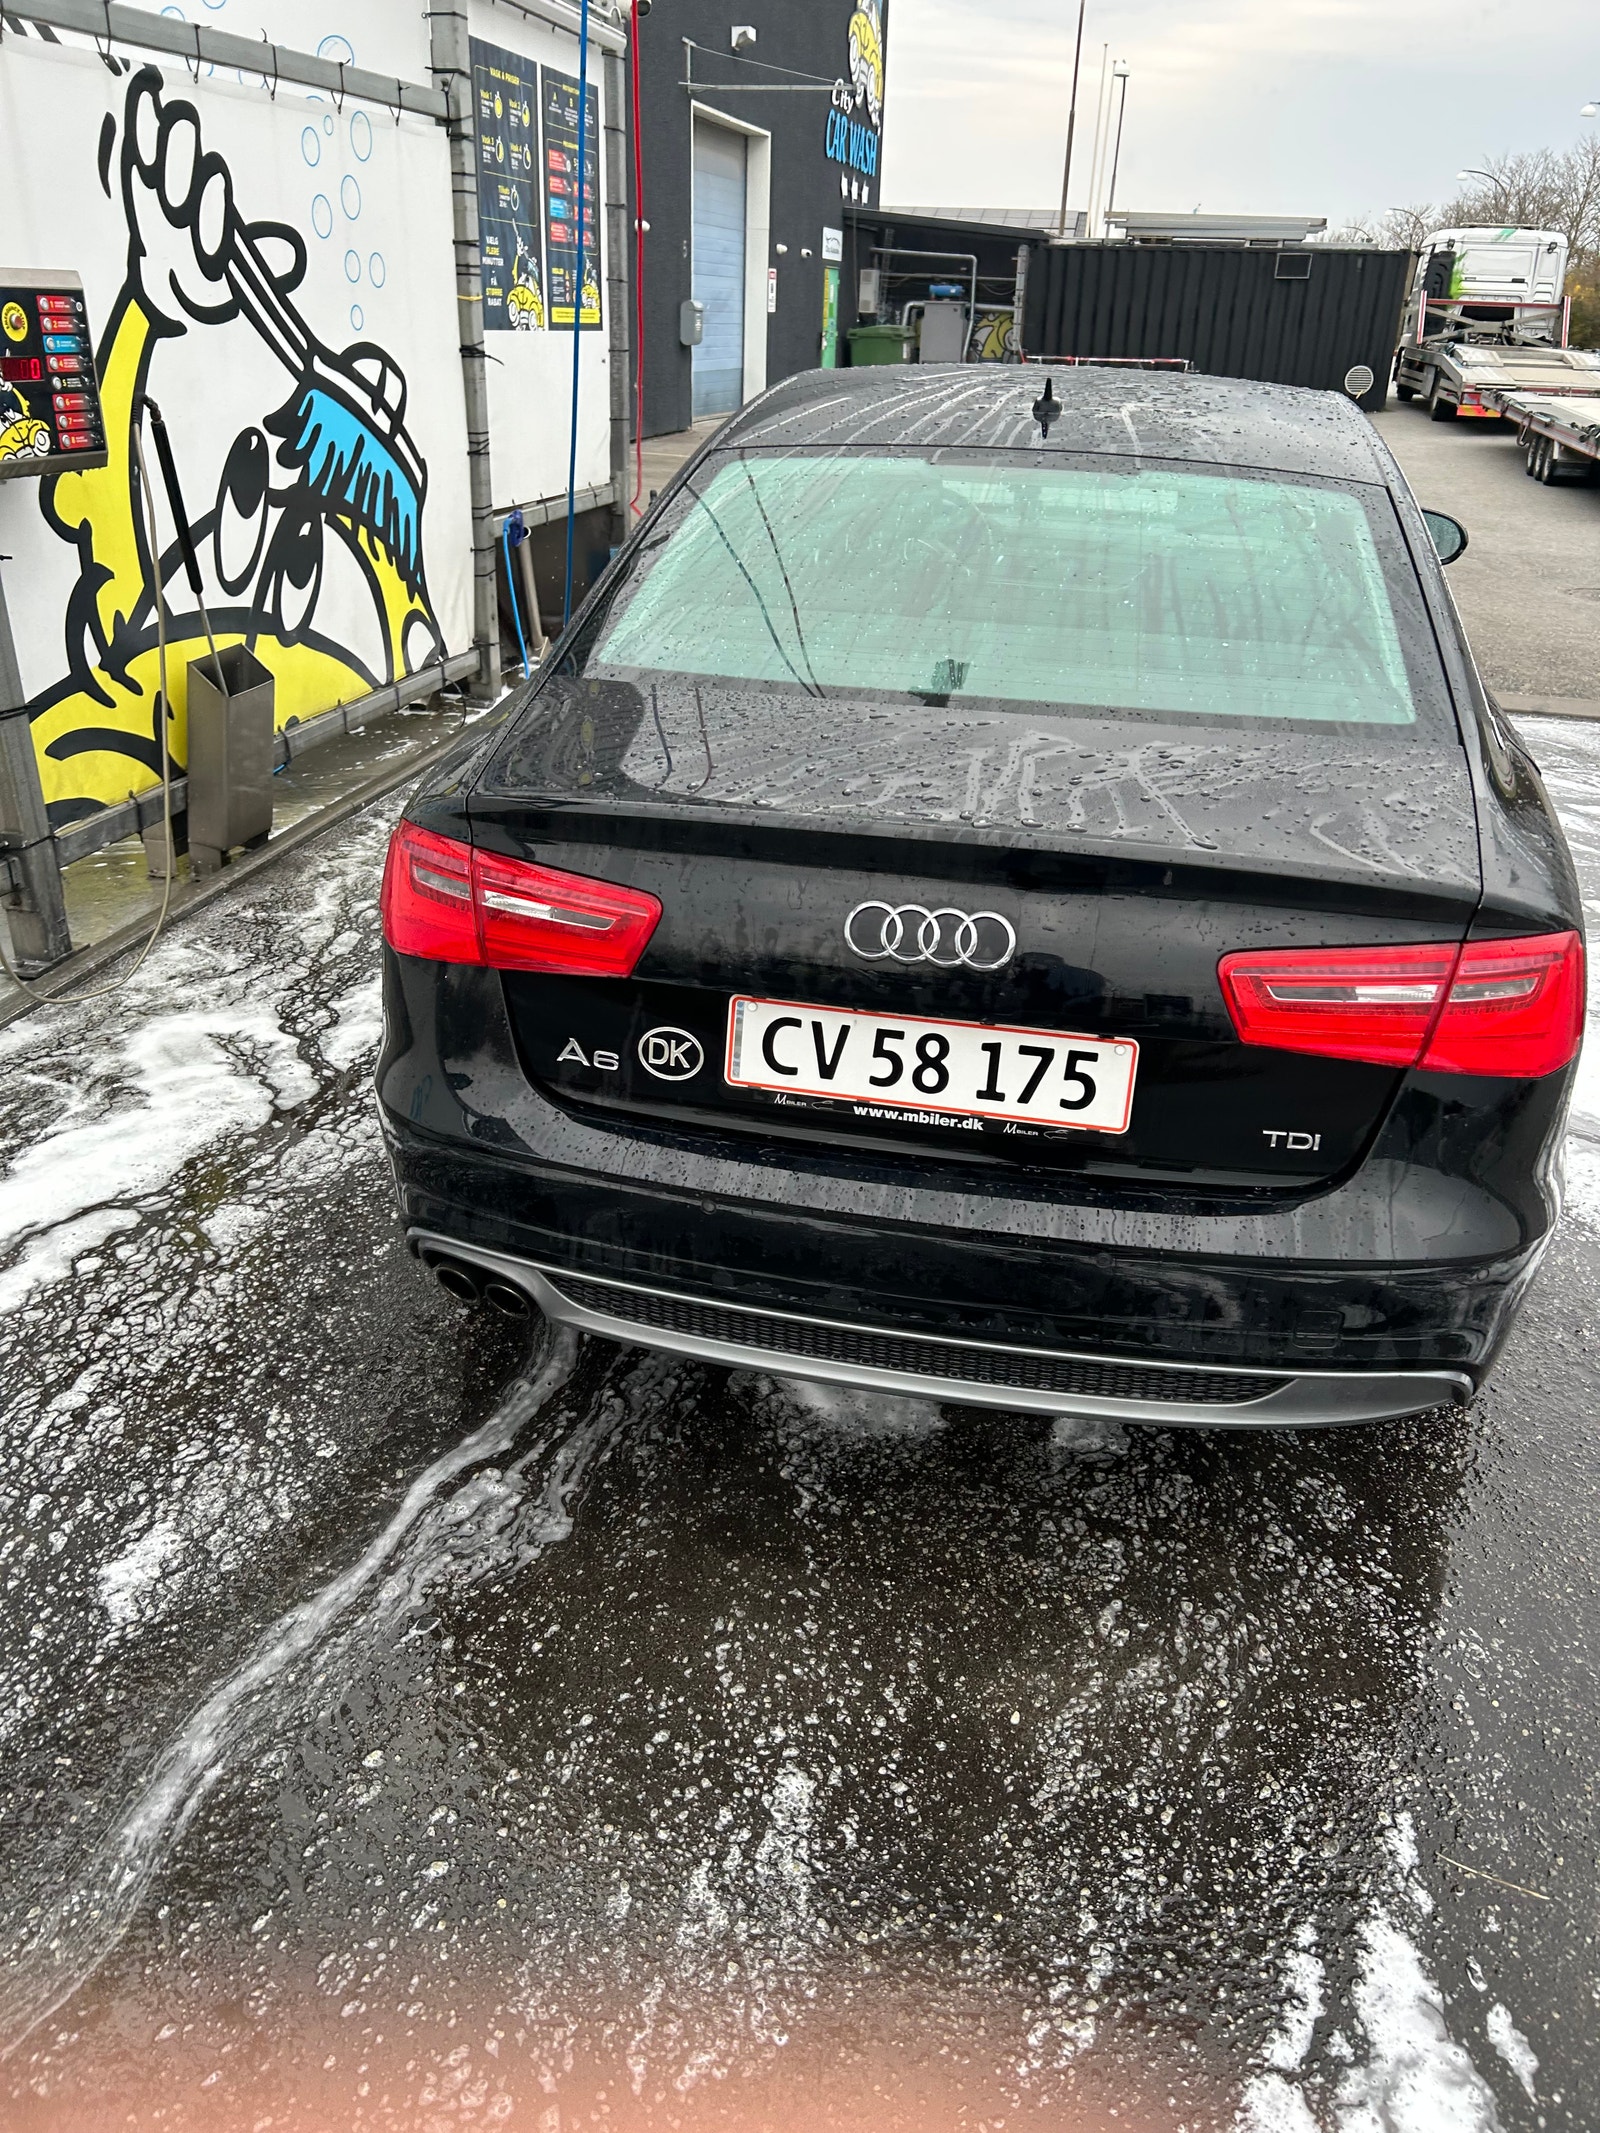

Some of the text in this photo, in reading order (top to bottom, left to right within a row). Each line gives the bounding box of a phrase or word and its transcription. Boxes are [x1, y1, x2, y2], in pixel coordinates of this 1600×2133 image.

[832, 78, 854, 114] City
[826, 109, 878, 177] CAR WASH
[556, 1037, 619, 1071] A6
[648, 1037, 692, 1069] DK
[761, 1016, 1099, 1111] CV 58 175
[853, 1105, 984, 1131] www.mbiler.dk
[1262, 1129, 1321, 1151] TDI
